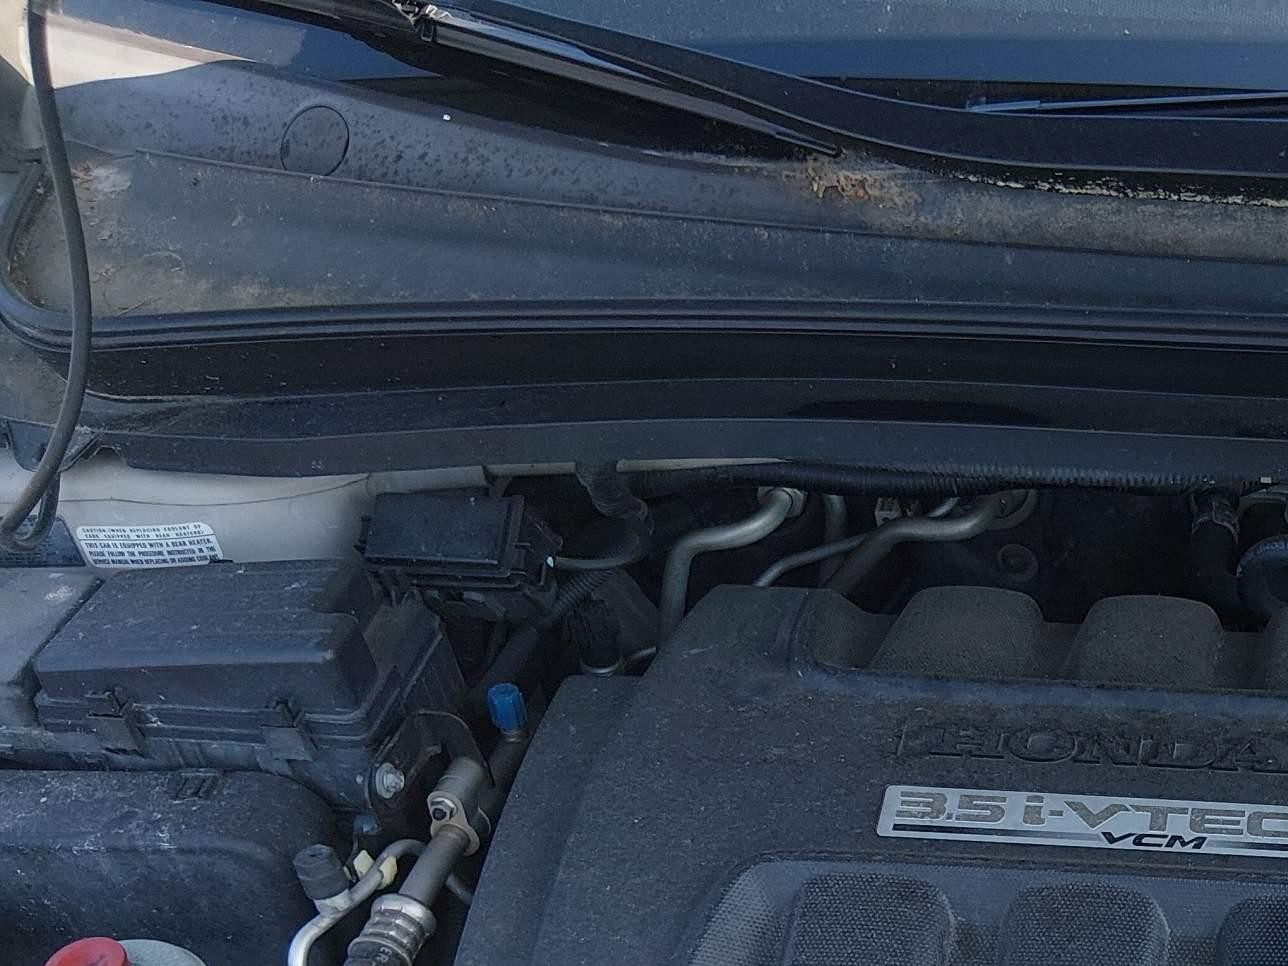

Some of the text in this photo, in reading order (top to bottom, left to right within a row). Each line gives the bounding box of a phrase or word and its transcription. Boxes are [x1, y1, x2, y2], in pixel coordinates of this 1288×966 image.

[147, 541, 164, 549] WITH
[895, 790, 1008, 825] 3.5
[1100, 831, 1209, 850] VCM
